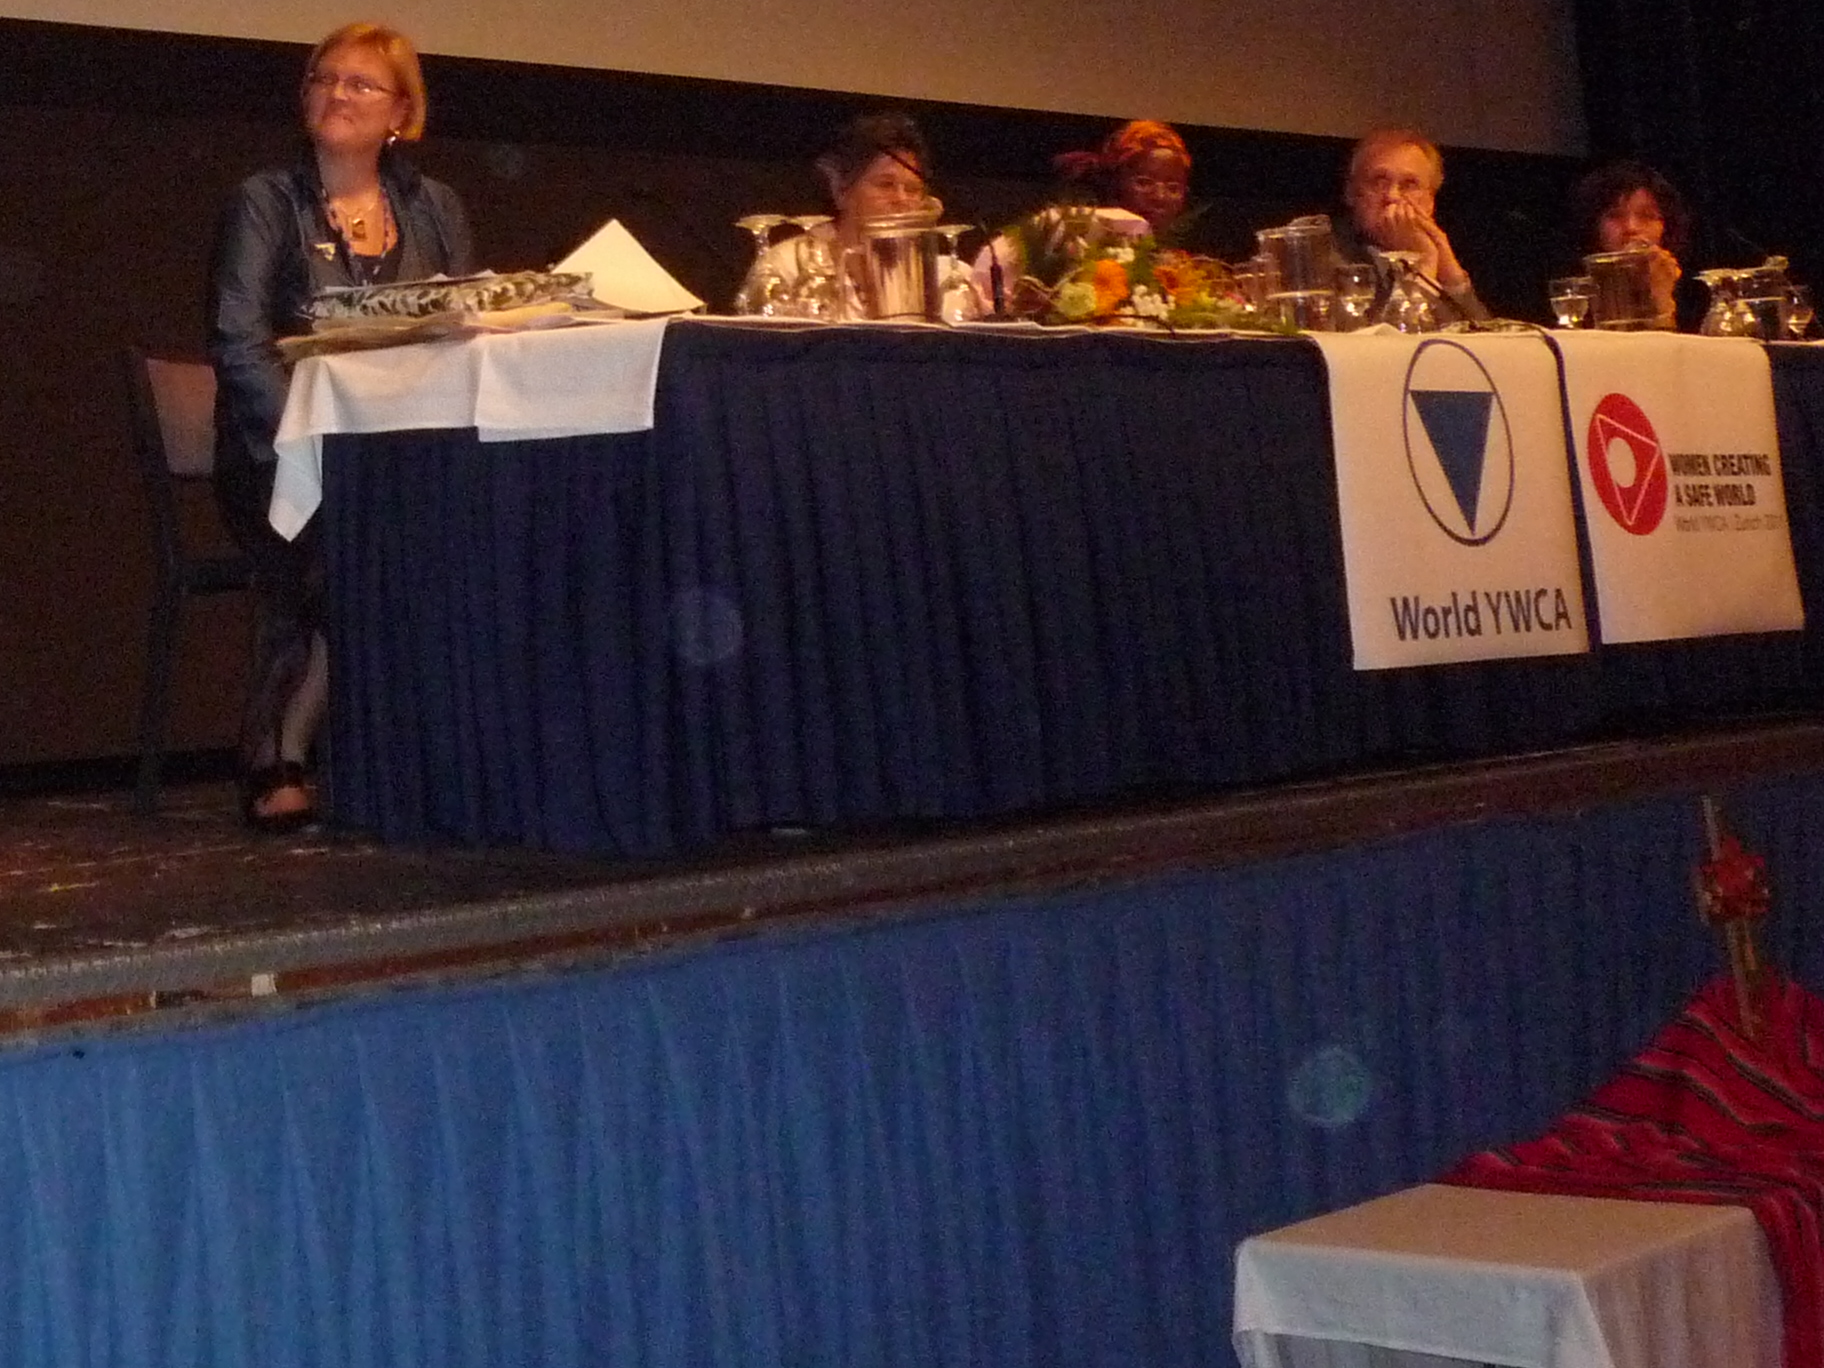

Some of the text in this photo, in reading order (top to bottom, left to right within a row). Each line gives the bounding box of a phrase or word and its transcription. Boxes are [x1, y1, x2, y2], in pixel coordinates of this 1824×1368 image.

[1713, 453, 1772, 476] CREATING
[1714, 483, 1756, 506] WORLD
[1389, 588, 1573, 641] World YWCA
